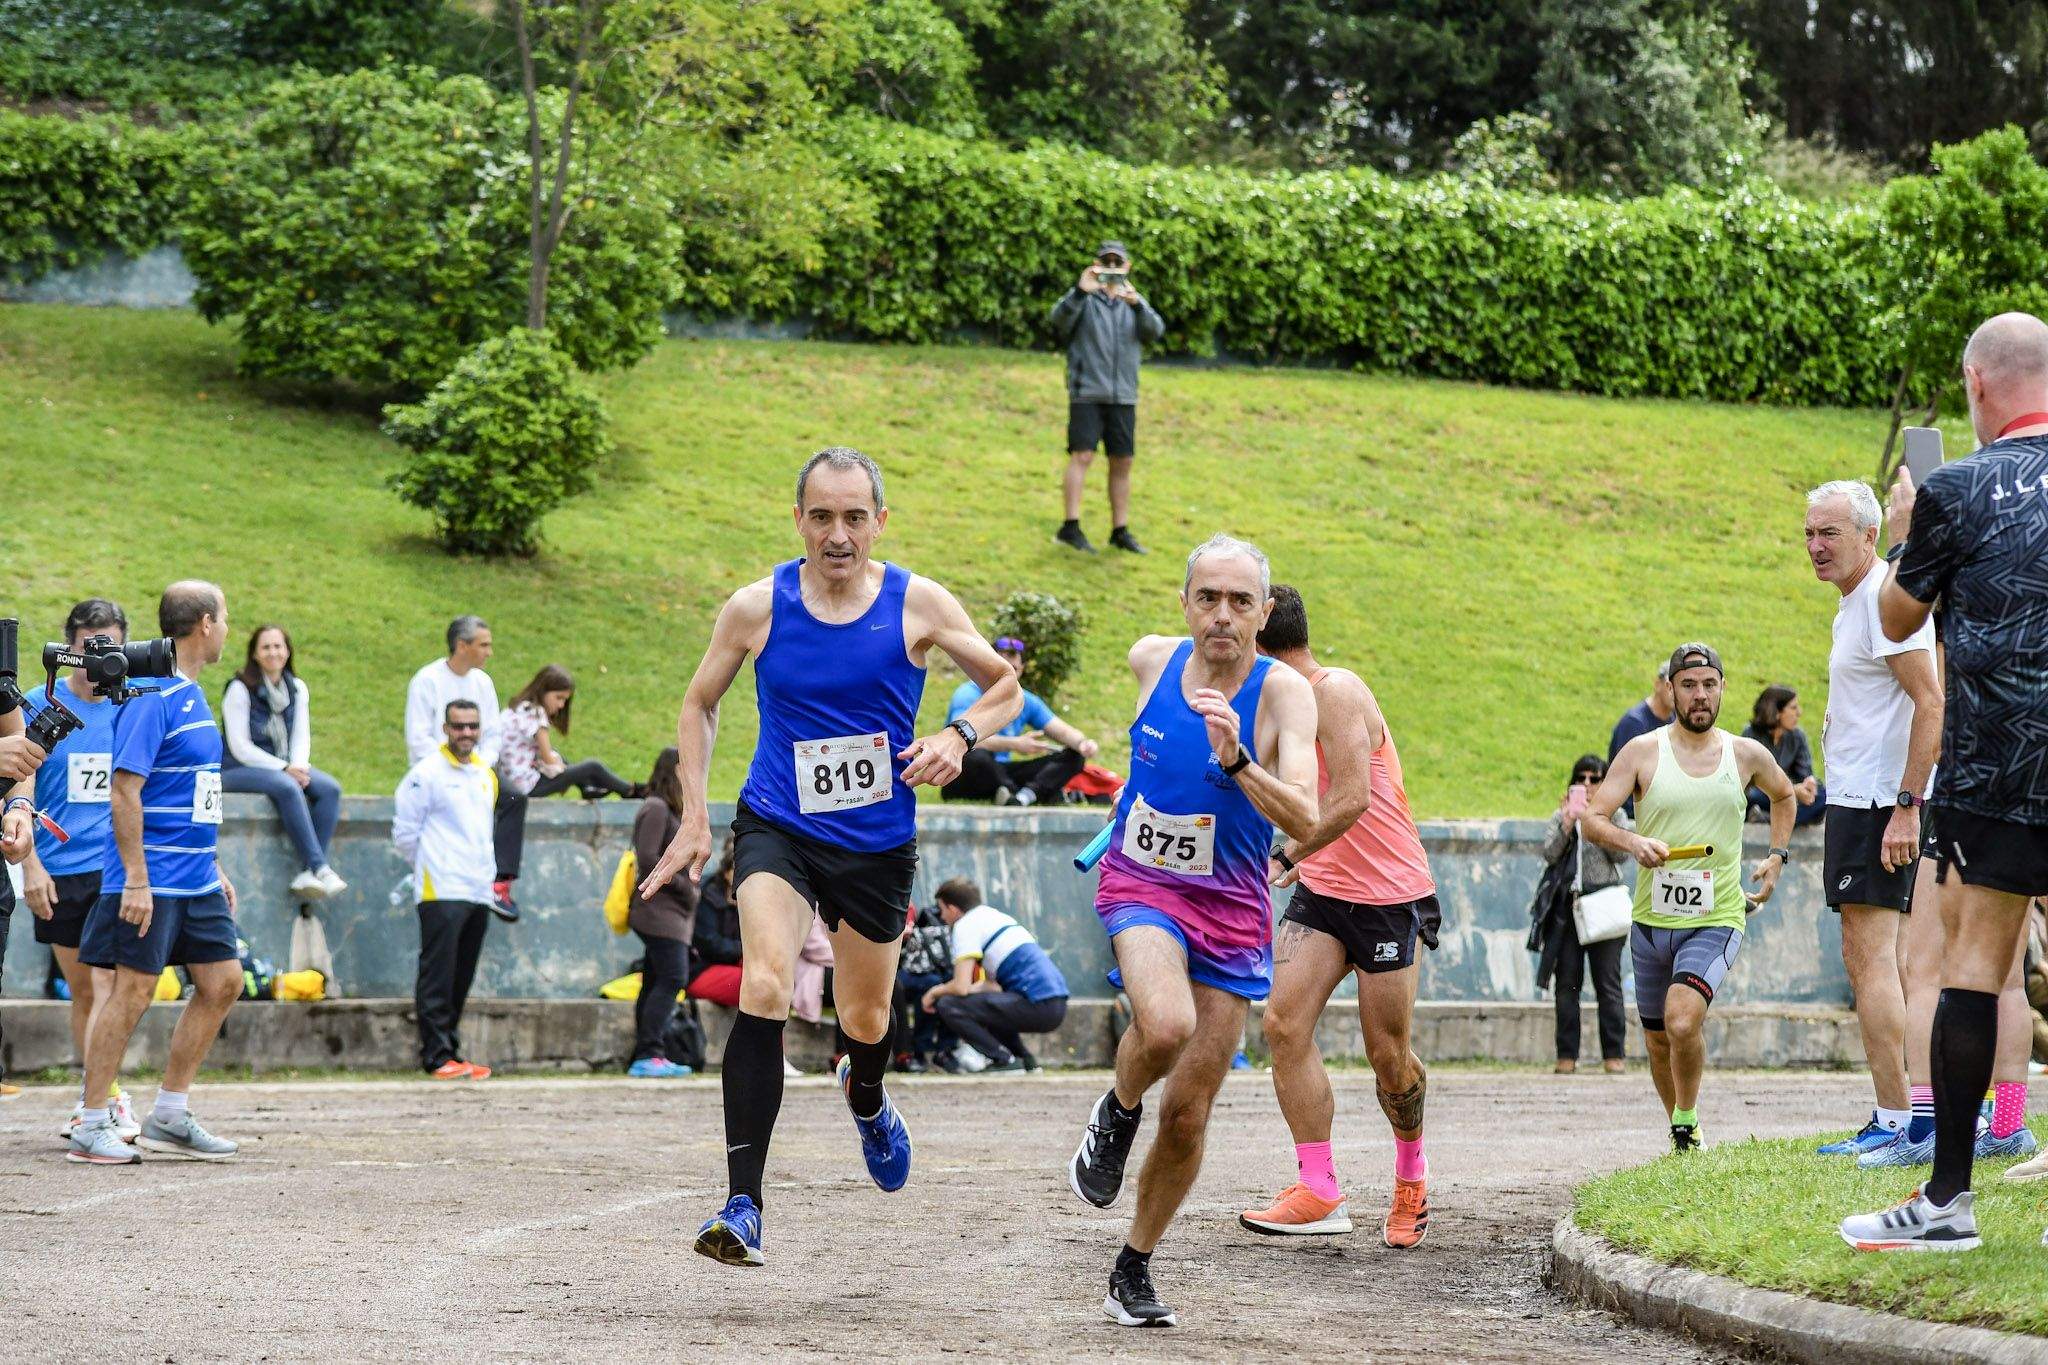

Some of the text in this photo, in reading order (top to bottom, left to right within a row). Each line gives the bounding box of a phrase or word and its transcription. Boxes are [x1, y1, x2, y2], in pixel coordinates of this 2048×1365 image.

[56, 653, 84, 666] RONIN
[814, 759, 875, 795] 819
[205, 789, 222, 810] 87
[871, 789, 889, 799] 2023
[1137, 823, 1196, 861] 875
[1188, 864, 1208, 872] 2023
[1661, 883, 1702, 906] 702
